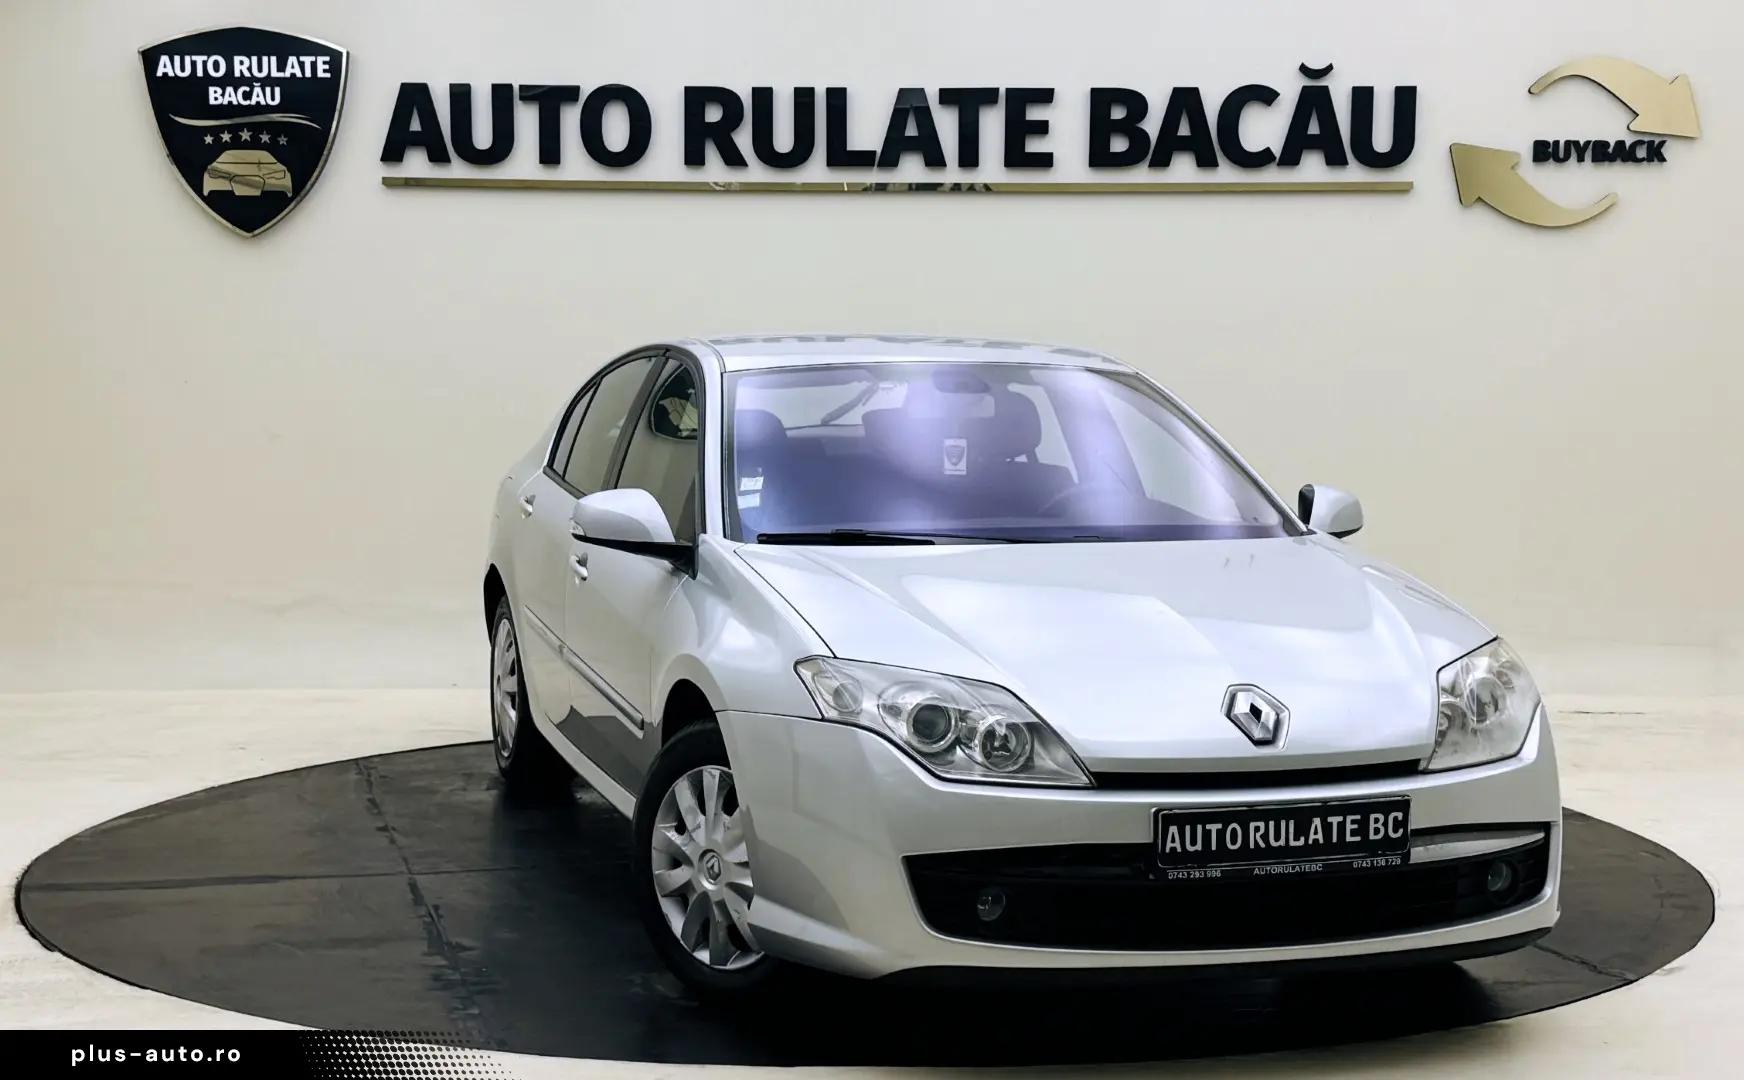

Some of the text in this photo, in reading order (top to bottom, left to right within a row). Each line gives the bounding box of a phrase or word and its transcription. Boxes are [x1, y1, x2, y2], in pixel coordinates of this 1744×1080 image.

[156, 55, 331, 79] AUTO RULATE
[208, 82, 281, 106] BACĂU
[380, 62, 1418, 170] AUTO RULATE BACĂU
[1532, 139, 1667, 163] BUYBACK
[1165, 811, 1404, 853] AUTO RULATE BC
[1168, 871, 1188, 880] 0743
[1190, 870, 1205, 879] 293
[1253, 864, 1323, 876] AUTORULATEBC
[1353, 860, 1371, 869] 0743
